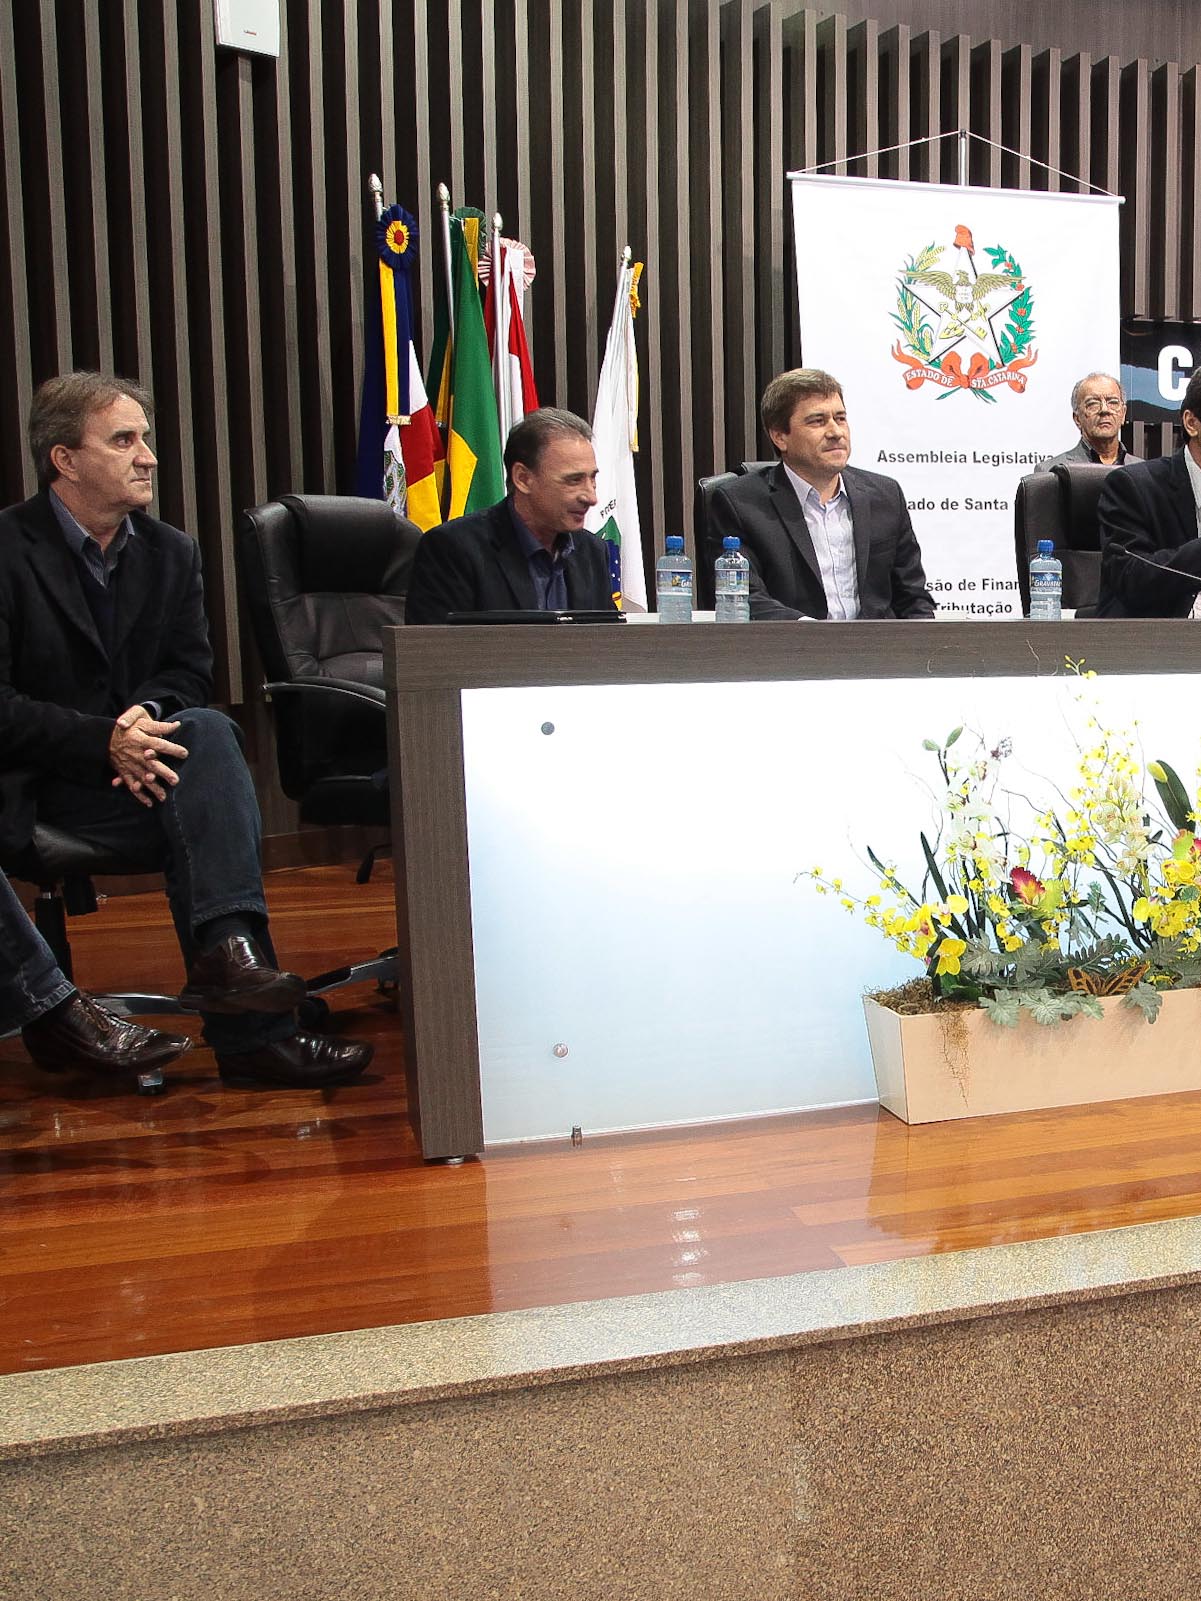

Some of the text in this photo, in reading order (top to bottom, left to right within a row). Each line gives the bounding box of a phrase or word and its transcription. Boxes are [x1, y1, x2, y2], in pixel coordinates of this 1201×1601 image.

[906, 369, 939, 381] ESTADO
[941, 376, 954, 387] DE
[877, 449, 967, 463] Assembleia
[940, 498, 960, 511] de
[964, 498, 1009, 511] Santa
[924, 578, 953, 592] são
[958, 578, 977, 591] de
